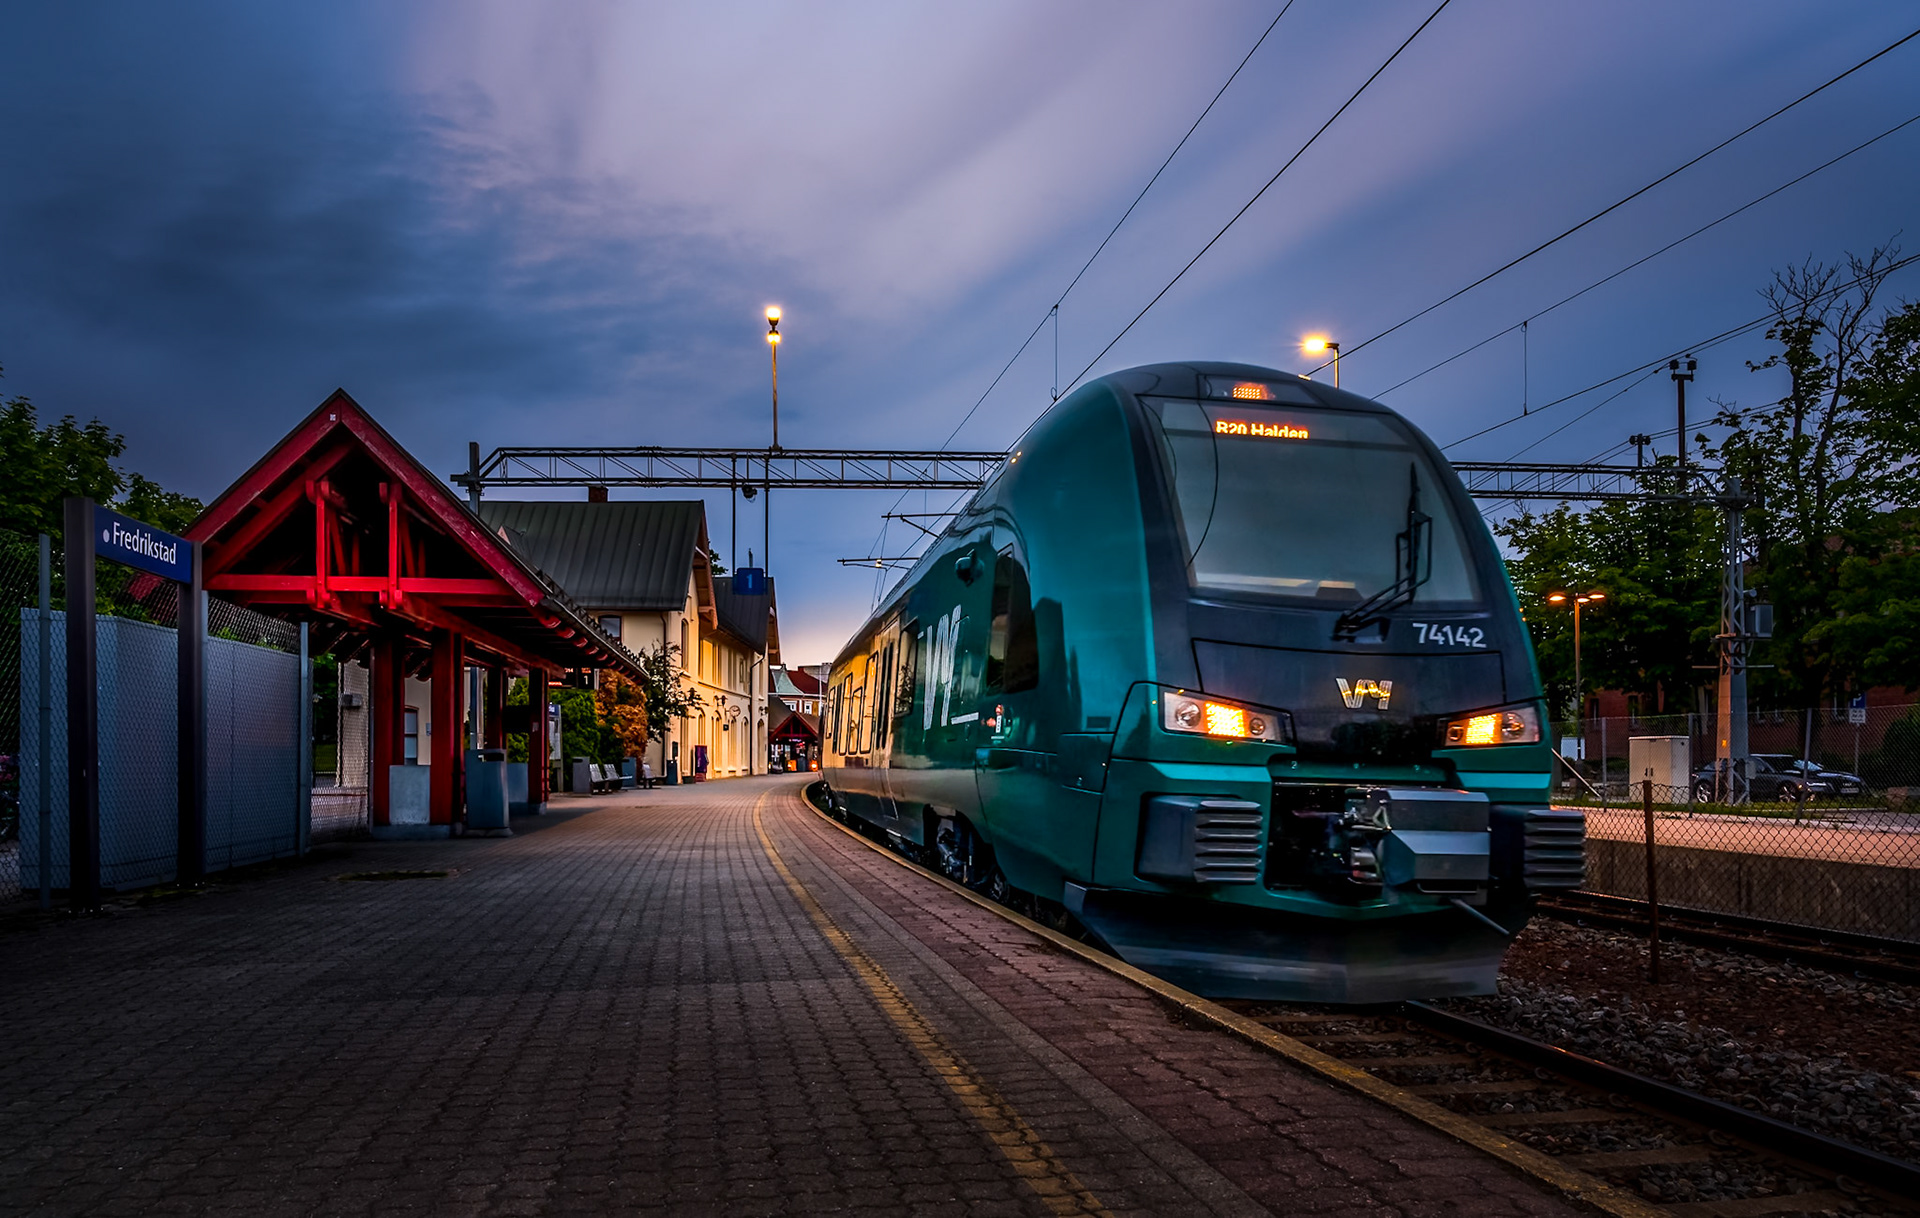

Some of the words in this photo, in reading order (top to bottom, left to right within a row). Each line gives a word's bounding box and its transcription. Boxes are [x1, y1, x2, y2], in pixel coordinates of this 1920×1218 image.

[113, 521, 177, 565] Fredrikstad
[746, 573, 753, 589] 1
[1412, 622, 1487, 648] 74142
[583, 675, 589, 685] 1
